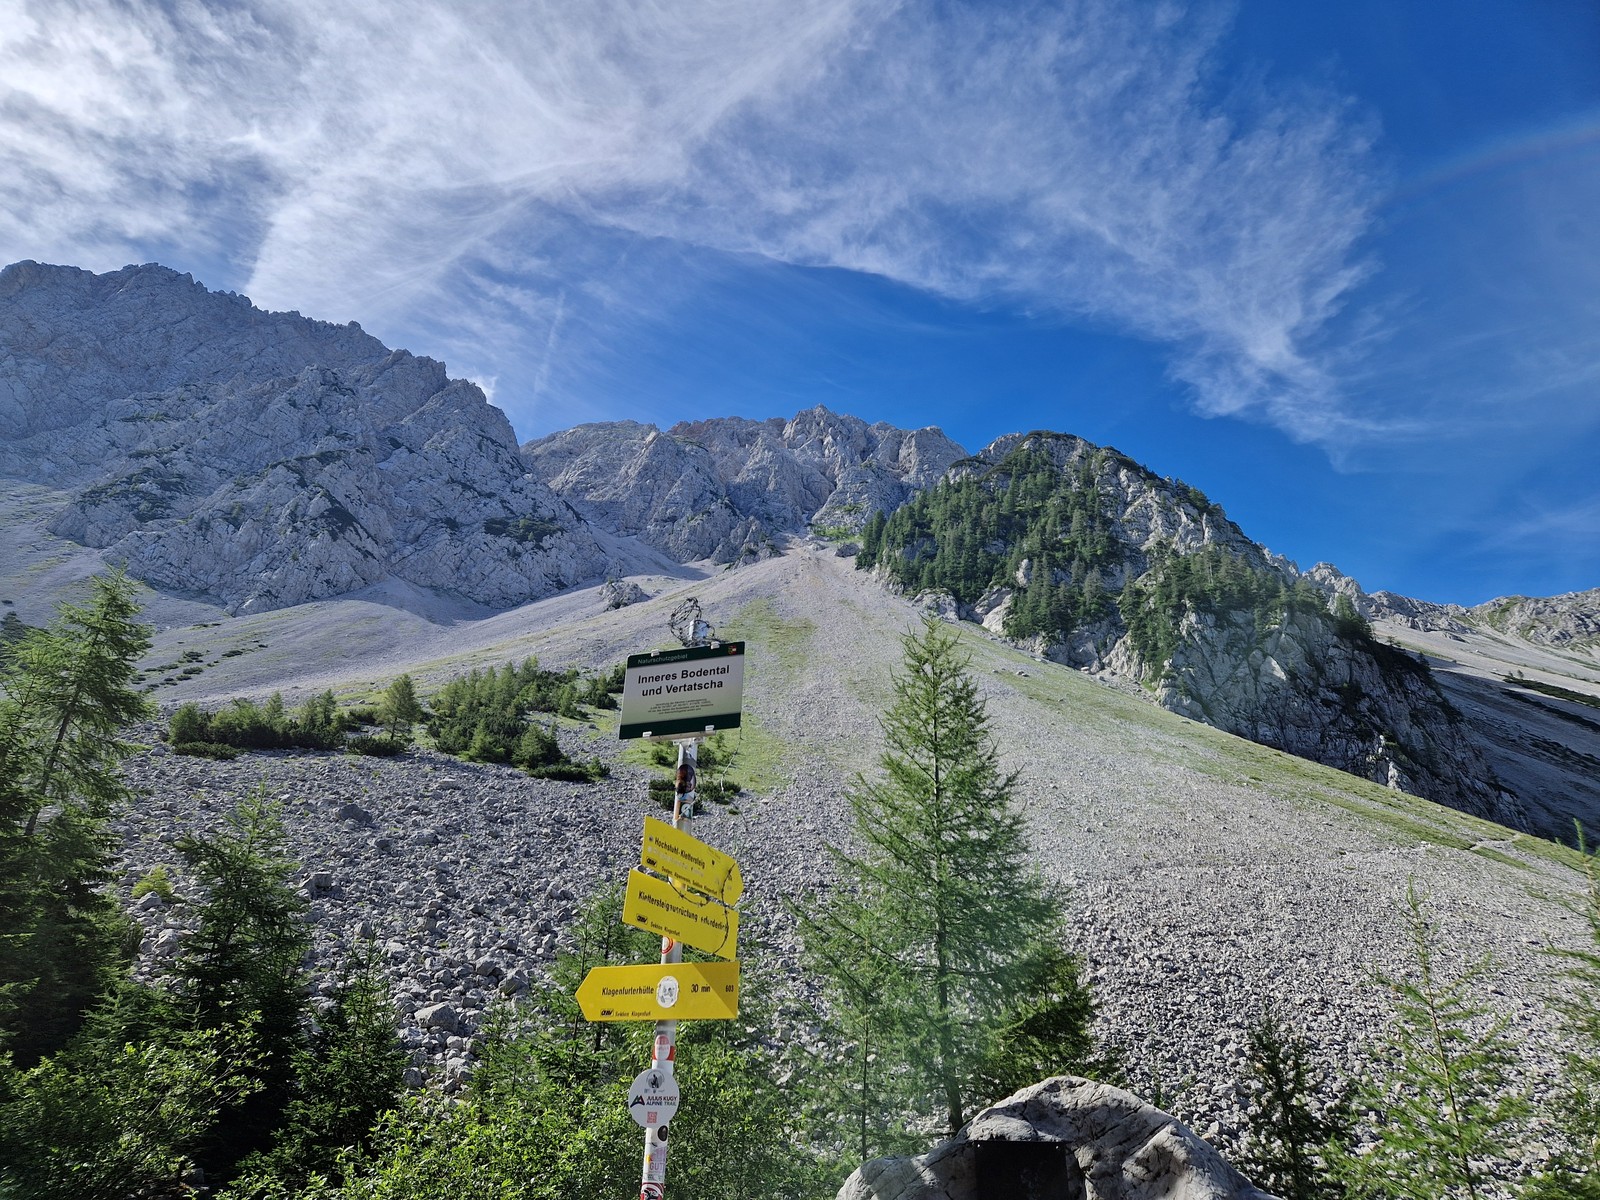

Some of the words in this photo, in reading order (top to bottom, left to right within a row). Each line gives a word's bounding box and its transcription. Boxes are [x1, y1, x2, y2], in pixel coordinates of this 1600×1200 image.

[637, 653, 688, 665] Naturschutzgebiet
[638, 672, 677, 684] Inneres
[681, 665, 730, 679] Bodental
[642, 685, 662, 697] und
[665, 679, 723, 694] Vertatscha
[601, 986, 655, 997] Klagenfurterhütte
[691, 984, 699, 993] 30
[700, 984, 711, 992] min
